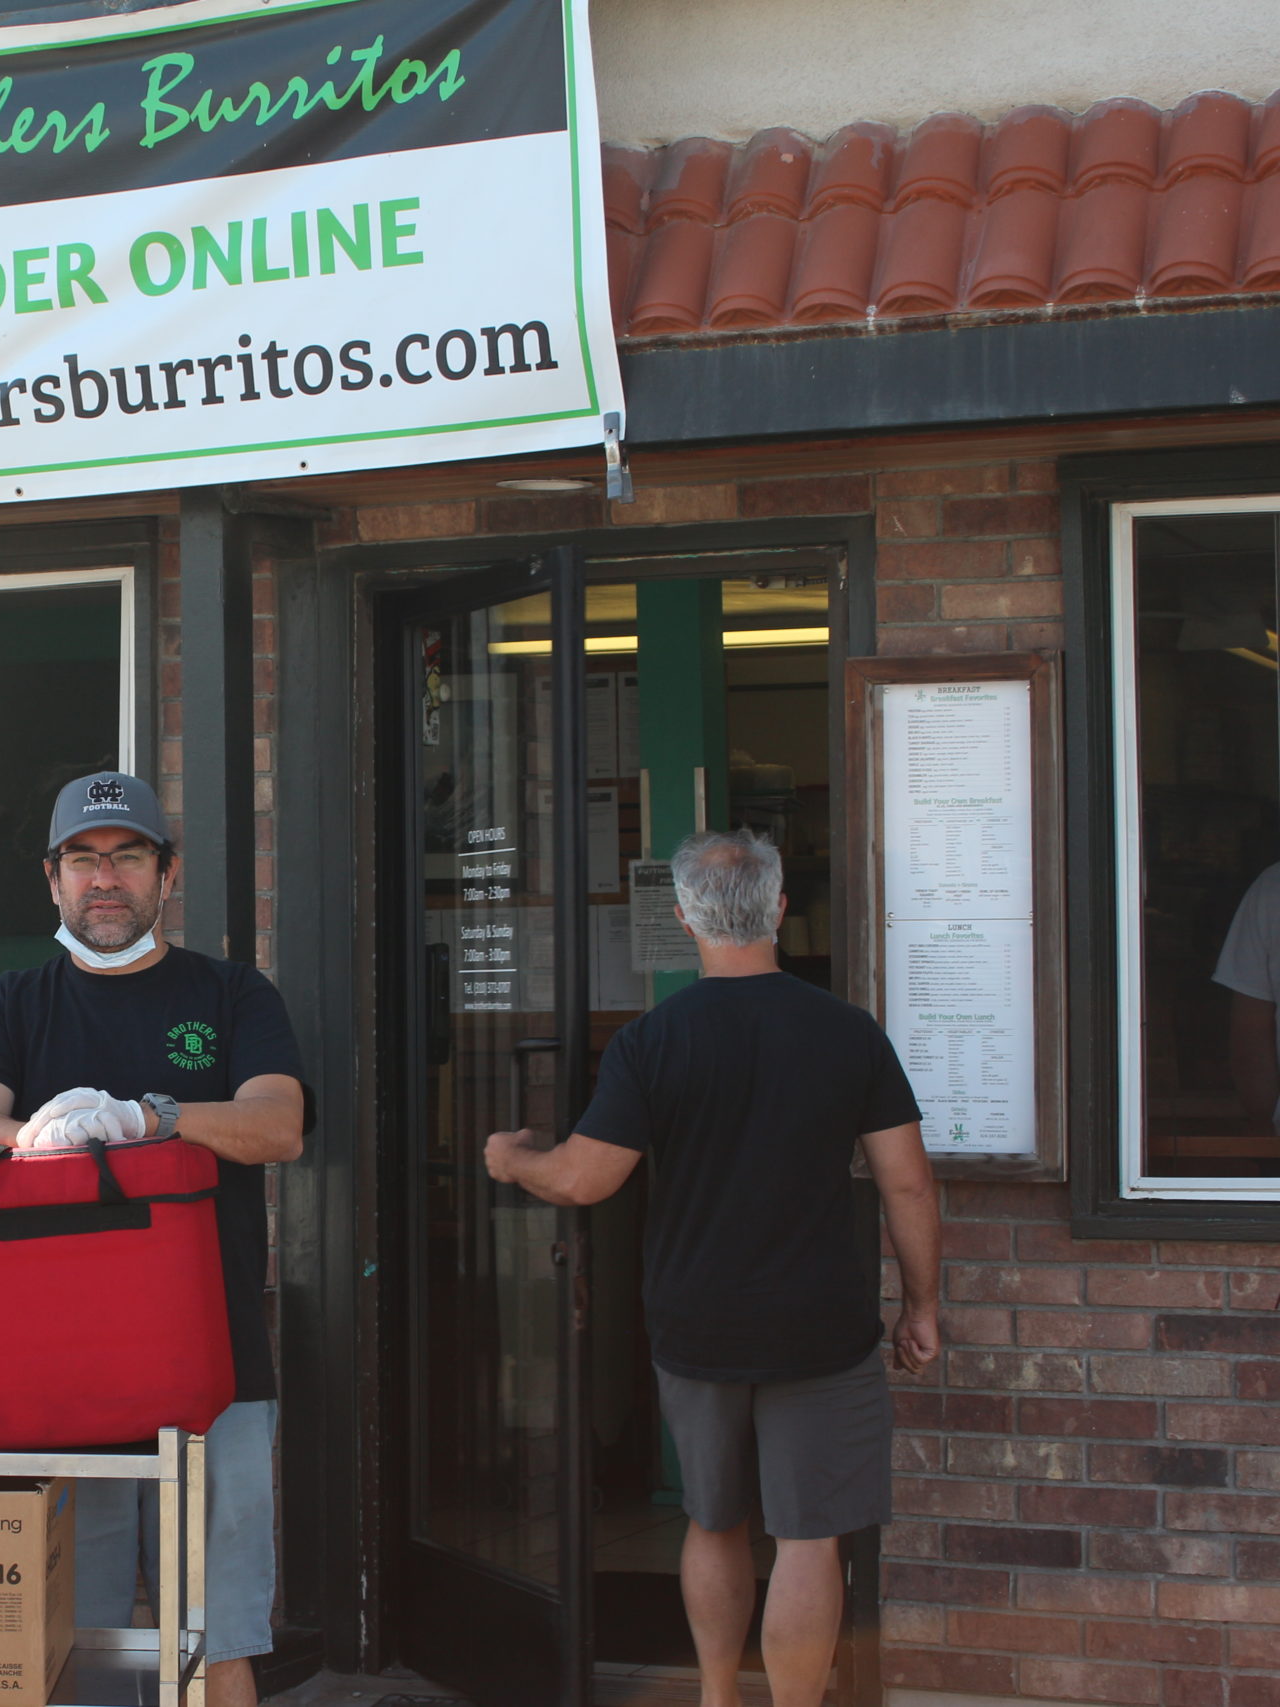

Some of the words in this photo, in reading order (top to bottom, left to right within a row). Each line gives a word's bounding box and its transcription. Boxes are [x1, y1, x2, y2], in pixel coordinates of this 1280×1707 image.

[140, 34, 466, 149] Burritos
[128, 197, 424, 298] ONLINE
[938, 686, 981, 694] BREAKFAST
[82, 803, 130, 813] FOOTBALL
[468, 829, 484, 844] OPEN
[485, 826, 506, 842] HOURS
[462, 863, 485, 880] Monday
[493, 861, 511, 878] Friday
[461, 924, 485, 942] Saturday
[492, 923, 513, 941] Sunday
[167, 1021, 217, 1040] BROTHERS
[167, 1052, 216, 1070] BURRITOS
